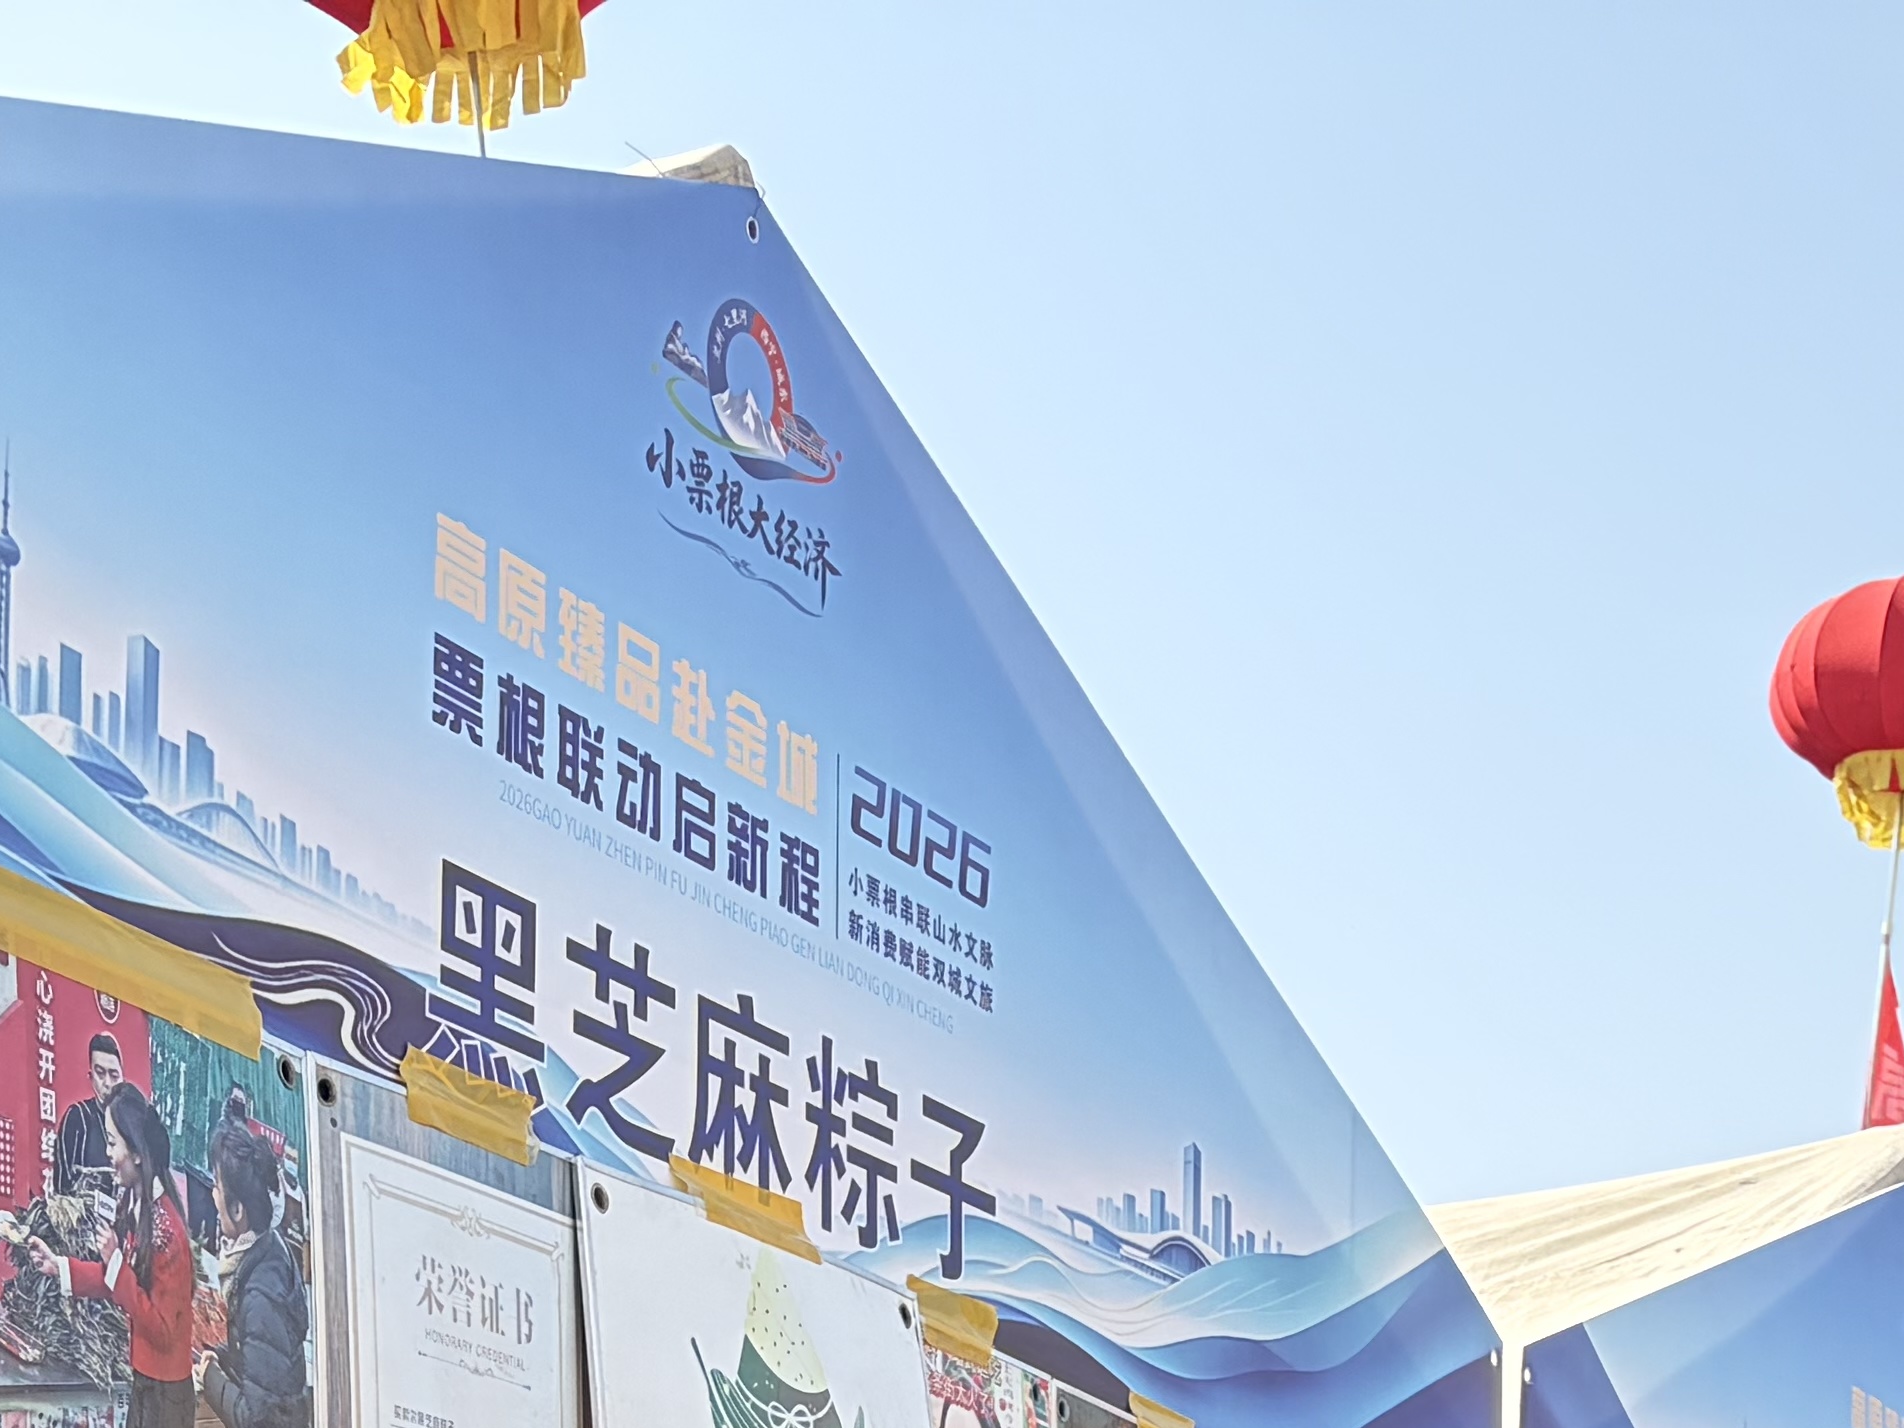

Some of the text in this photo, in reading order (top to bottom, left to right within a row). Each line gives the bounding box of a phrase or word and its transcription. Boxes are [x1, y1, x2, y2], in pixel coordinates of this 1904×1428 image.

[646, 428, 843, 612] 小票根大经济
[433, 511, 819, 816] 高原臻品赴金城
[431, 631, 821, 928] 票根联动启新程
[850, 765, 993, 909] 2026
[847, 908, 994, 1014] 新消费赋能双城文旅
[848, 866, 995, 972] 小票根串联山水文脉
[424, 857, 997, 1281] 黑芝麻粽子
[415, 1254, 534, 1345] 荣誉证书
